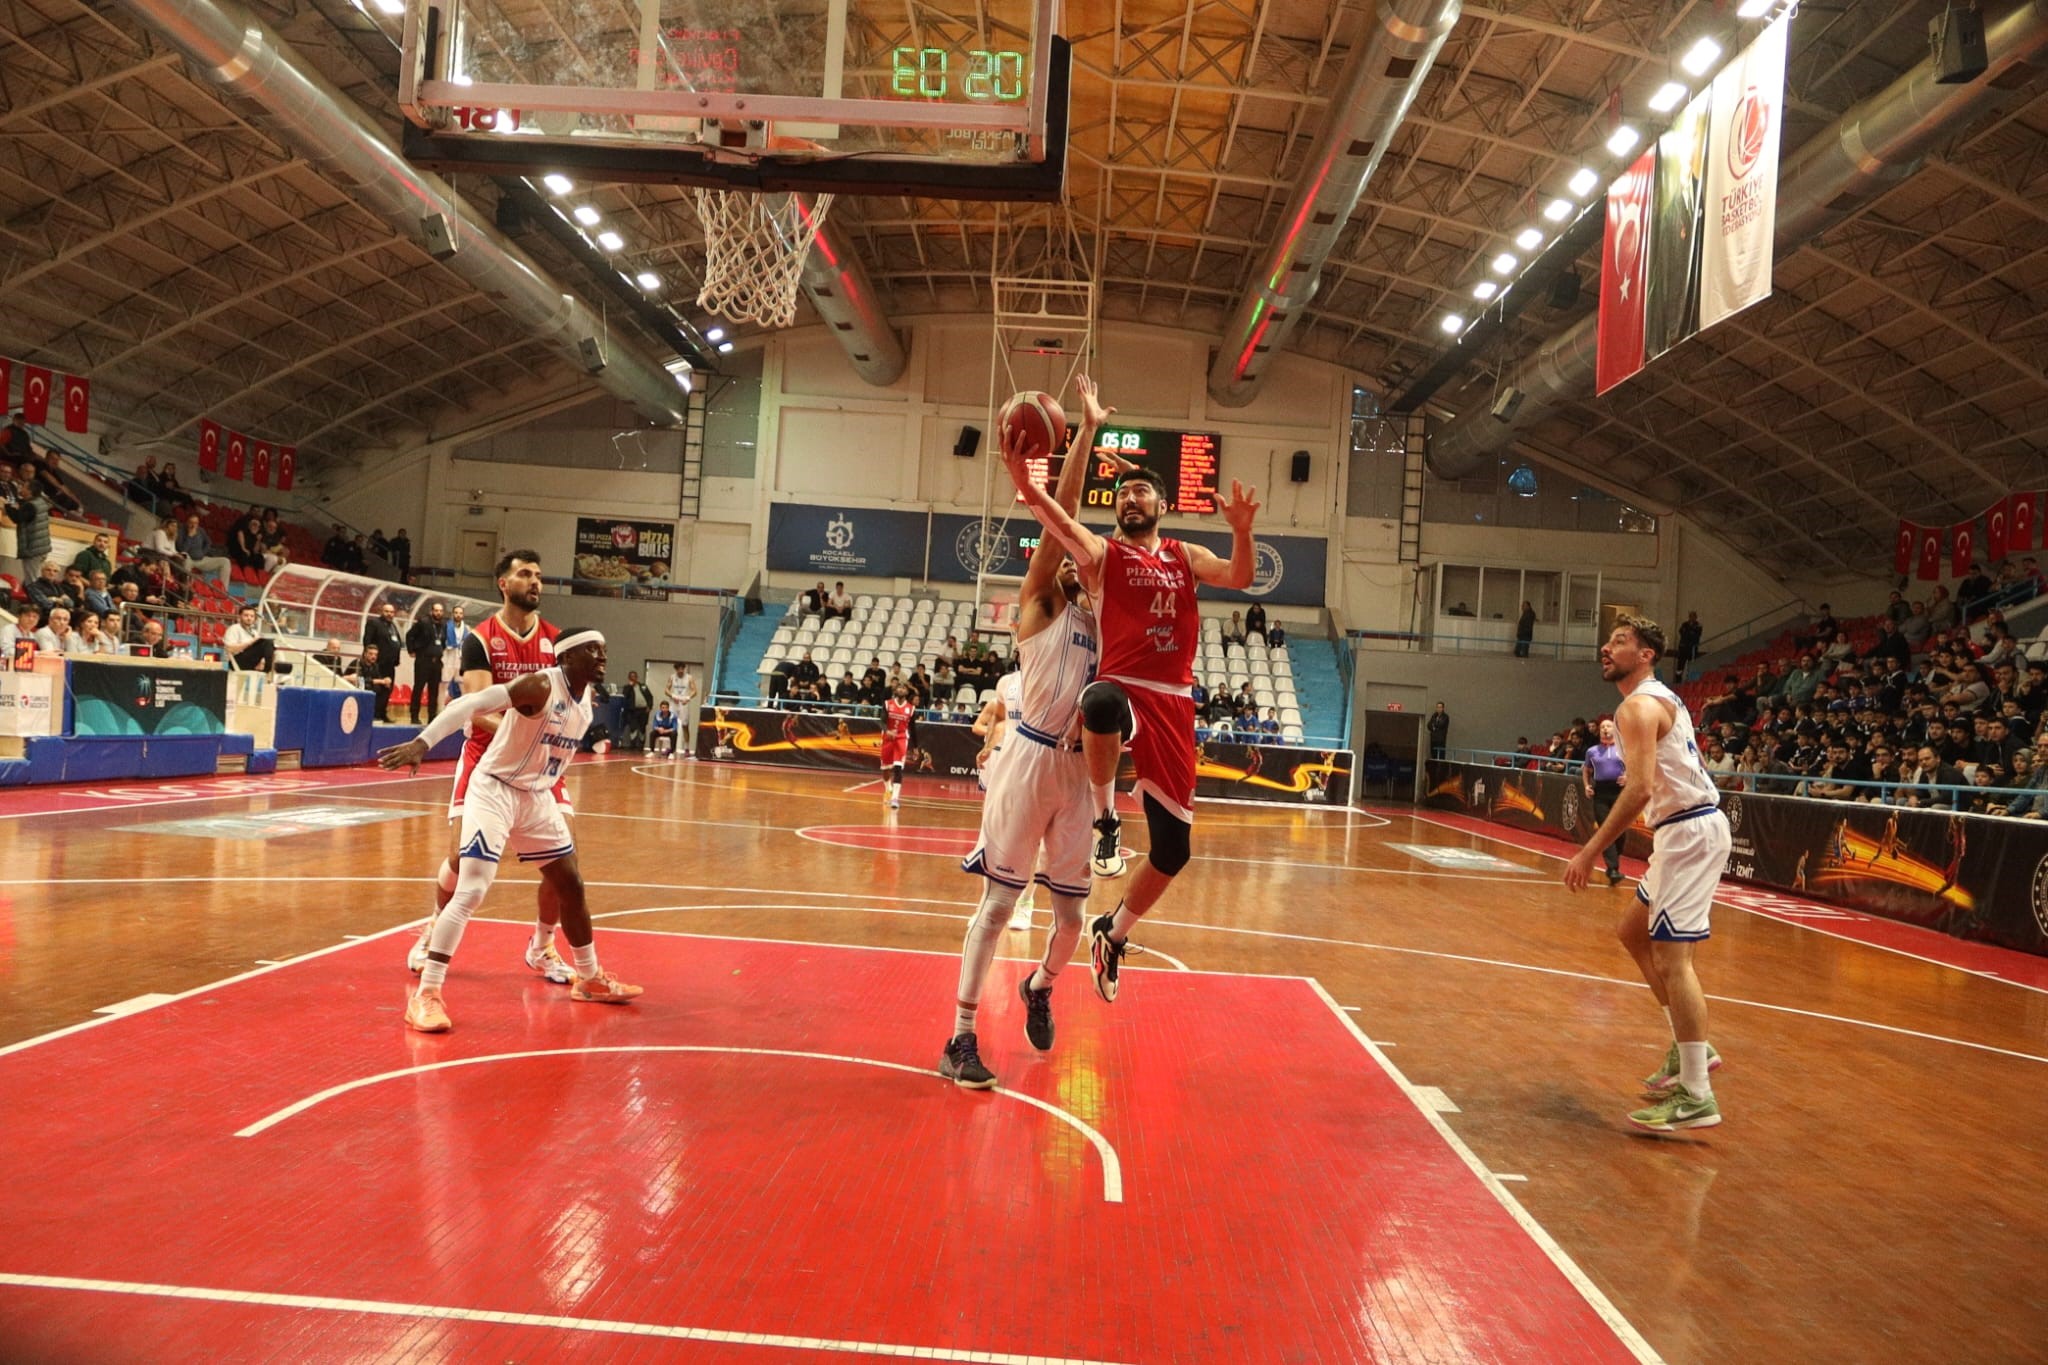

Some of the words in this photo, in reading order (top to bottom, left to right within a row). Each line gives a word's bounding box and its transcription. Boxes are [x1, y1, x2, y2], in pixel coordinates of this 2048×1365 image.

[638, 542, 671, 559] BULLS
[1149, 591, 1176, 619] 44
[16, 641, 34, 670] 2
[950, 766, 969, 775] DEV
[1735, 861, 1754, 880] İZMİT
